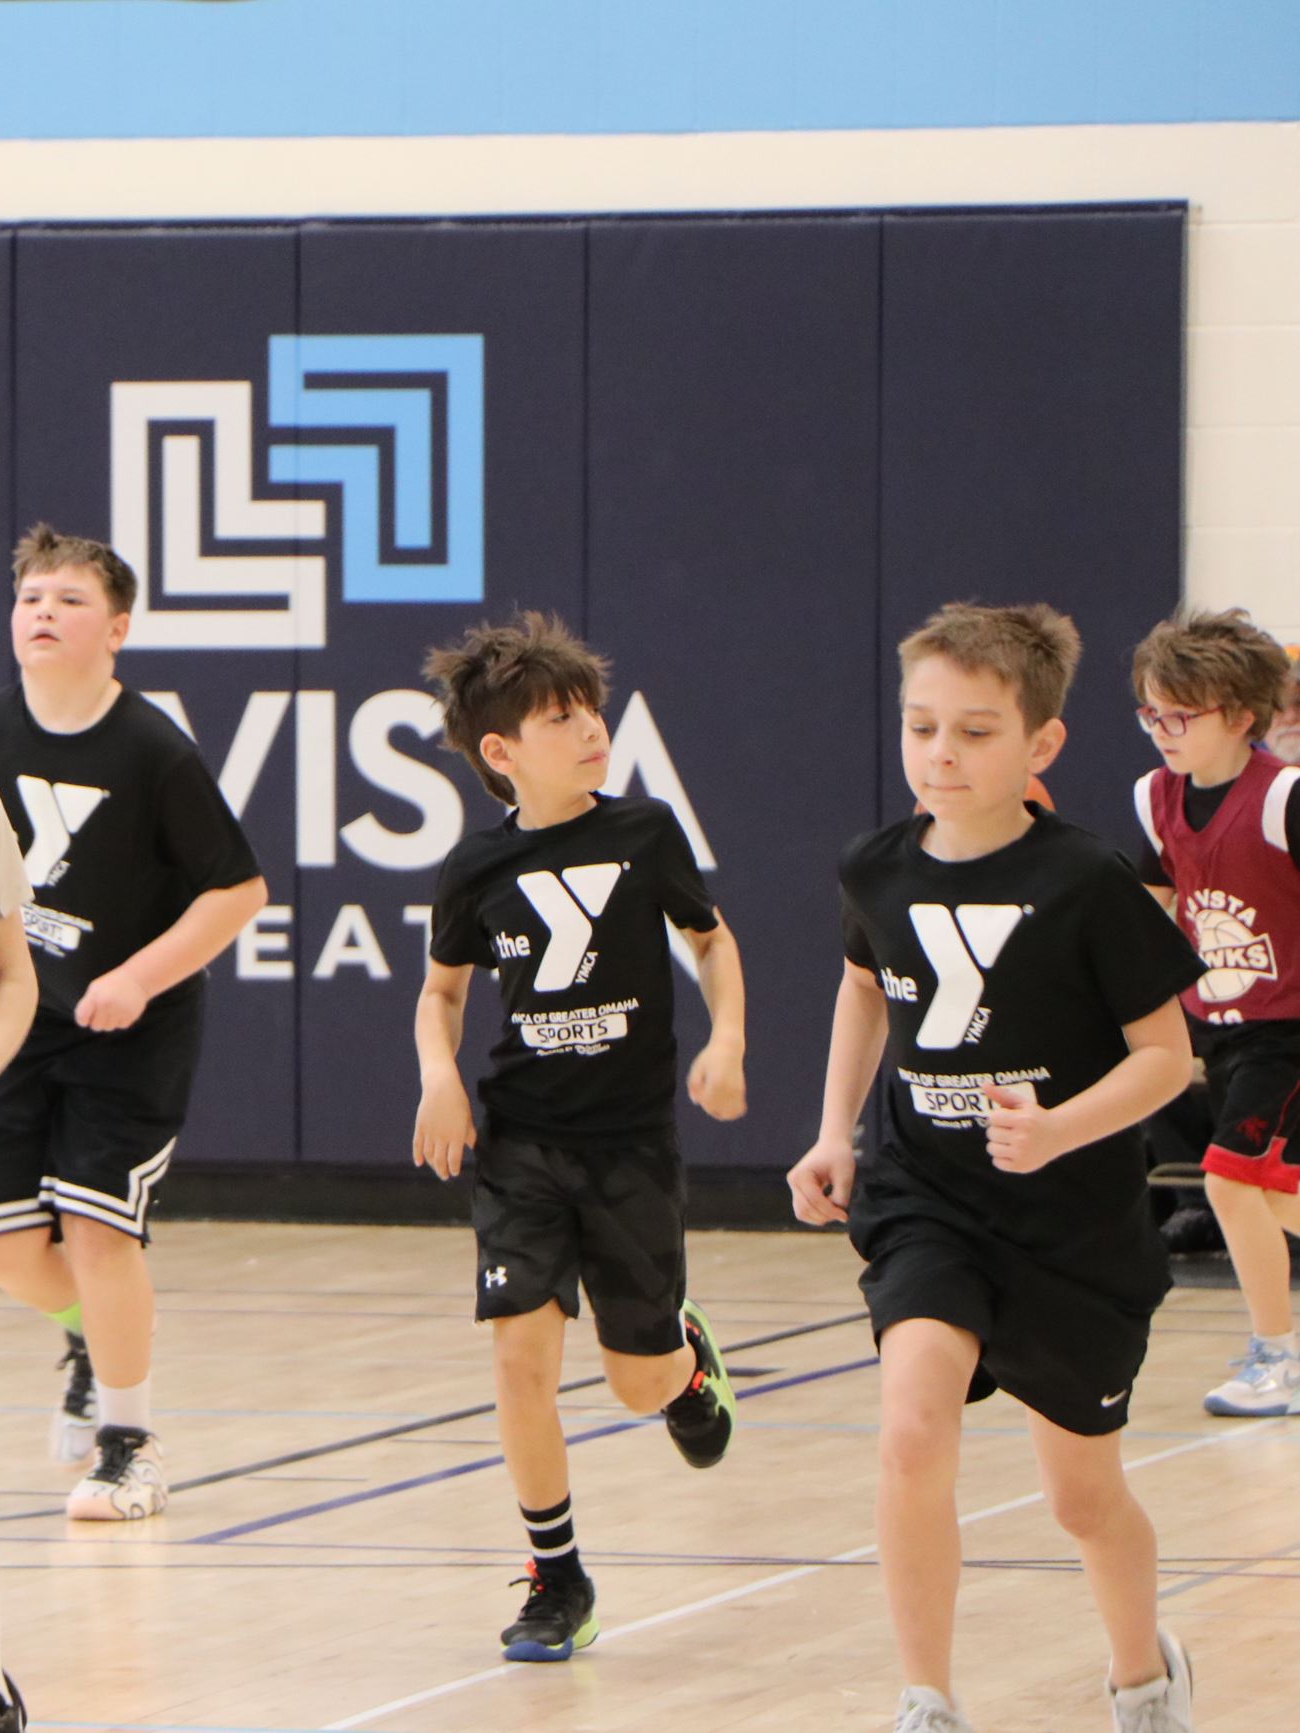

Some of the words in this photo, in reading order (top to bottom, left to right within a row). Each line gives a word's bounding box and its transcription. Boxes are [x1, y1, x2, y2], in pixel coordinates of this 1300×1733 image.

[140, 688, 718, 872] VISA
[496, 930, 532, 960] the
[1203, 943, 1269, 969] WKS
[574, 951, 599, 985] YMCA
[880, 966, 919, 1003] the
[532, 1012, 549, 1024] OF
[548, 1006, 597, 1024] GREATER
[598, 997, 640, 1017] OMAHA
[963, 1005, 993, 1045] YMCA
[924, 1091, 994, 1112] SPORT
